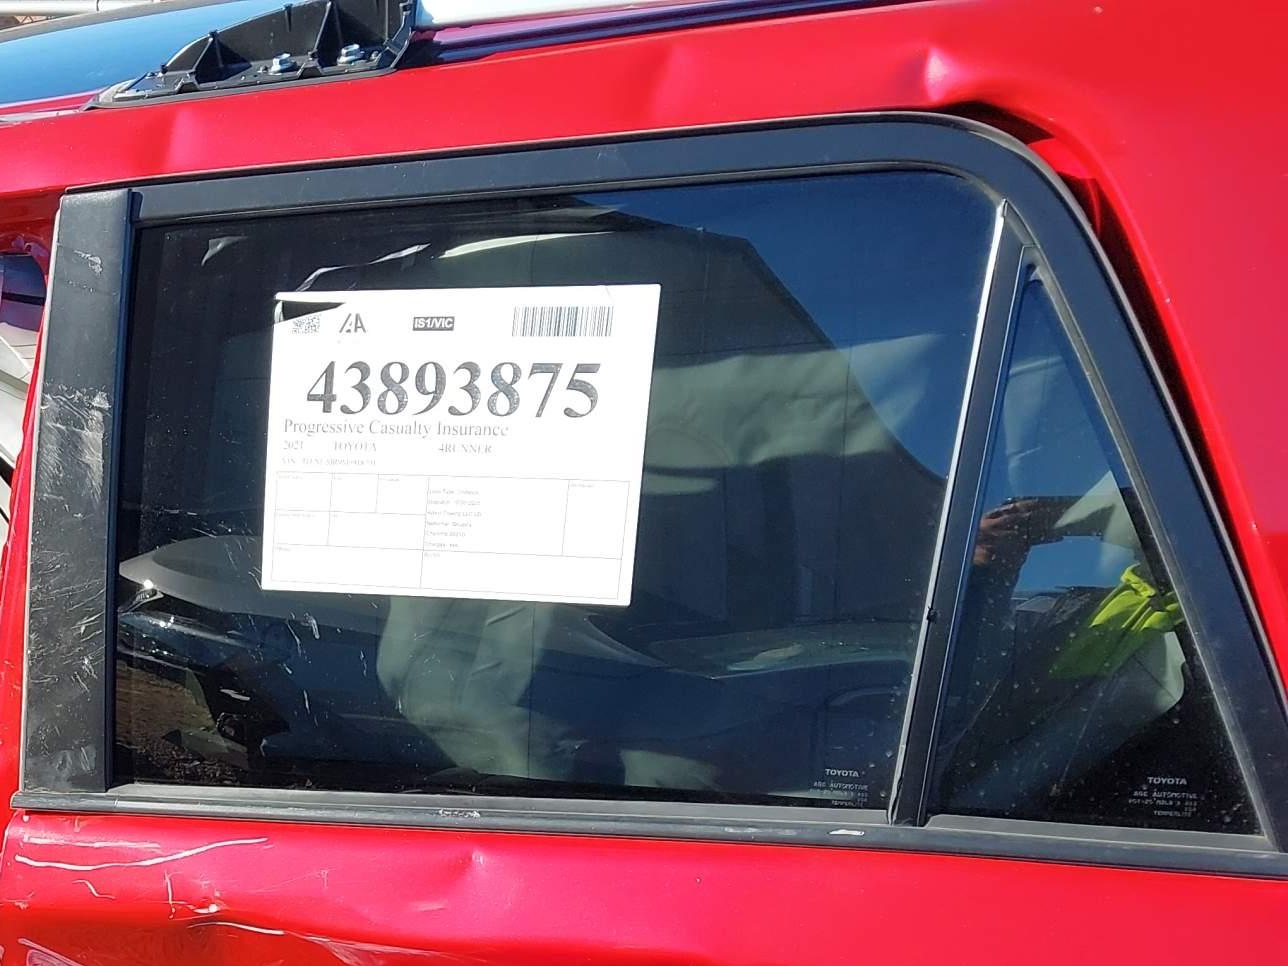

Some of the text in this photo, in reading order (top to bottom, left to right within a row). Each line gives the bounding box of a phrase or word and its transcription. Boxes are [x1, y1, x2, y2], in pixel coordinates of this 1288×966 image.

[306, 360, 601, 418] 43893875
[284, 418, 509, 439] Progressive Casualty Insurance
[332, 441, 377, 452] TOYOTA
[825, 768, 860, 777] TOYOTA
[1147, 776, 1188, 785] TOYOTA
